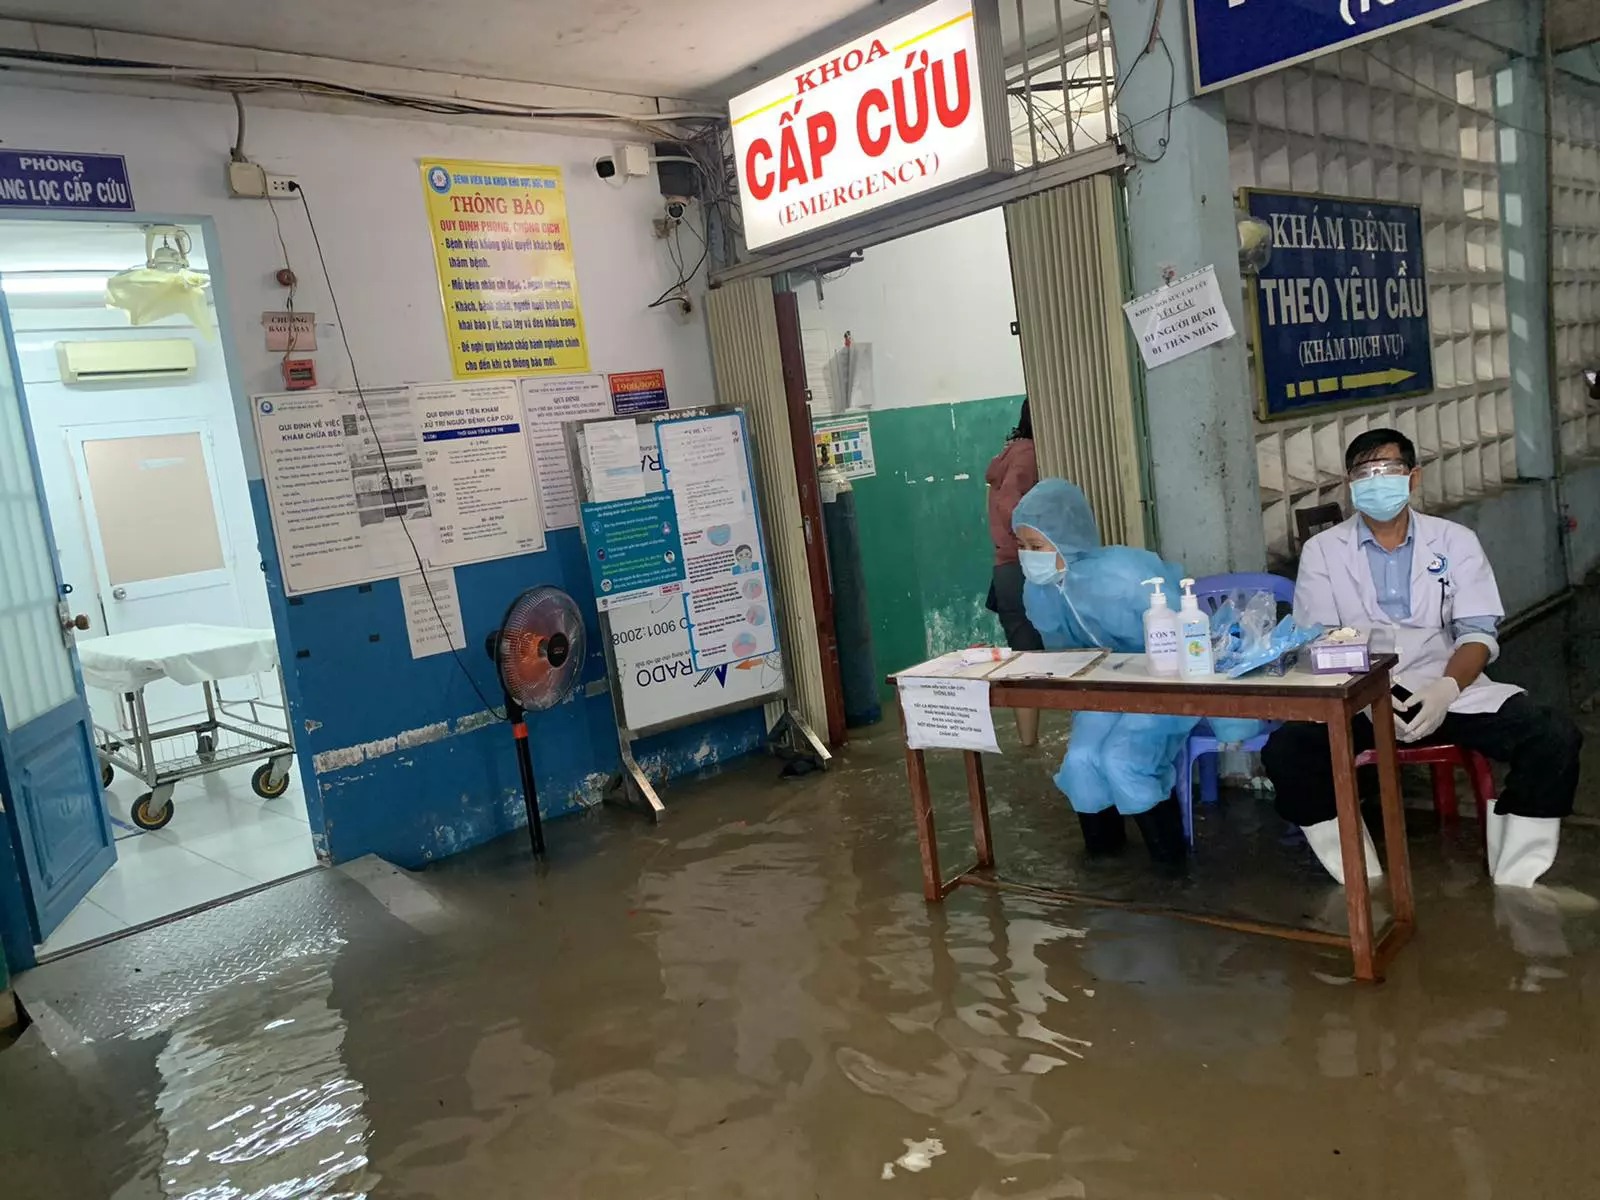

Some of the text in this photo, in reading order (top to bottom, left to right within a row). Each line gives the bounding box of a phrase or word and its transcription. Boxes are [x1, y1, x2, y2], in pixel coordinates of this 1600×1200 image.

[794, 39, 889, 95] KHOA
[745, 49, 971, 201] CẤP CỨU
[19, 156, 84, 173] PHÒNG
[29, 180, 62, 205] LỌC
[64, 174, 92, 202] CẤP
[97, 177, 127, 204] CỨU
[450, 192, 545, 215] THÔNG BÁO
[779, 152, 940, 227] (EMERGENCY)
[440, 219, 456, 232] QUY
[459, 220, 480, 234] ĐỊNH
[1270, 205, 1408, 259] KHÁM BỆNH
[445, 238, 463, 251] Bệnh
[1260, 260, 1424, 325] THEO YÊU CẦU
[1157, 317, 1190, 337] NGƯỜI
[1190, 306, 1217, 325] BỆNH
[1152, 320, 1219, 355] 01 THÂN NHÂN
[1300, 332, 1404, 368] (KHÁM DỊCH VỤ)
[278, 424, 292, 432] QUI
[294, 422, 312, 431] ĐỊNH
[426, 411, 438, 419] QUI
[612, 620, 676, 646] 9001:2008
[636, 658, 694, 687] RADO
